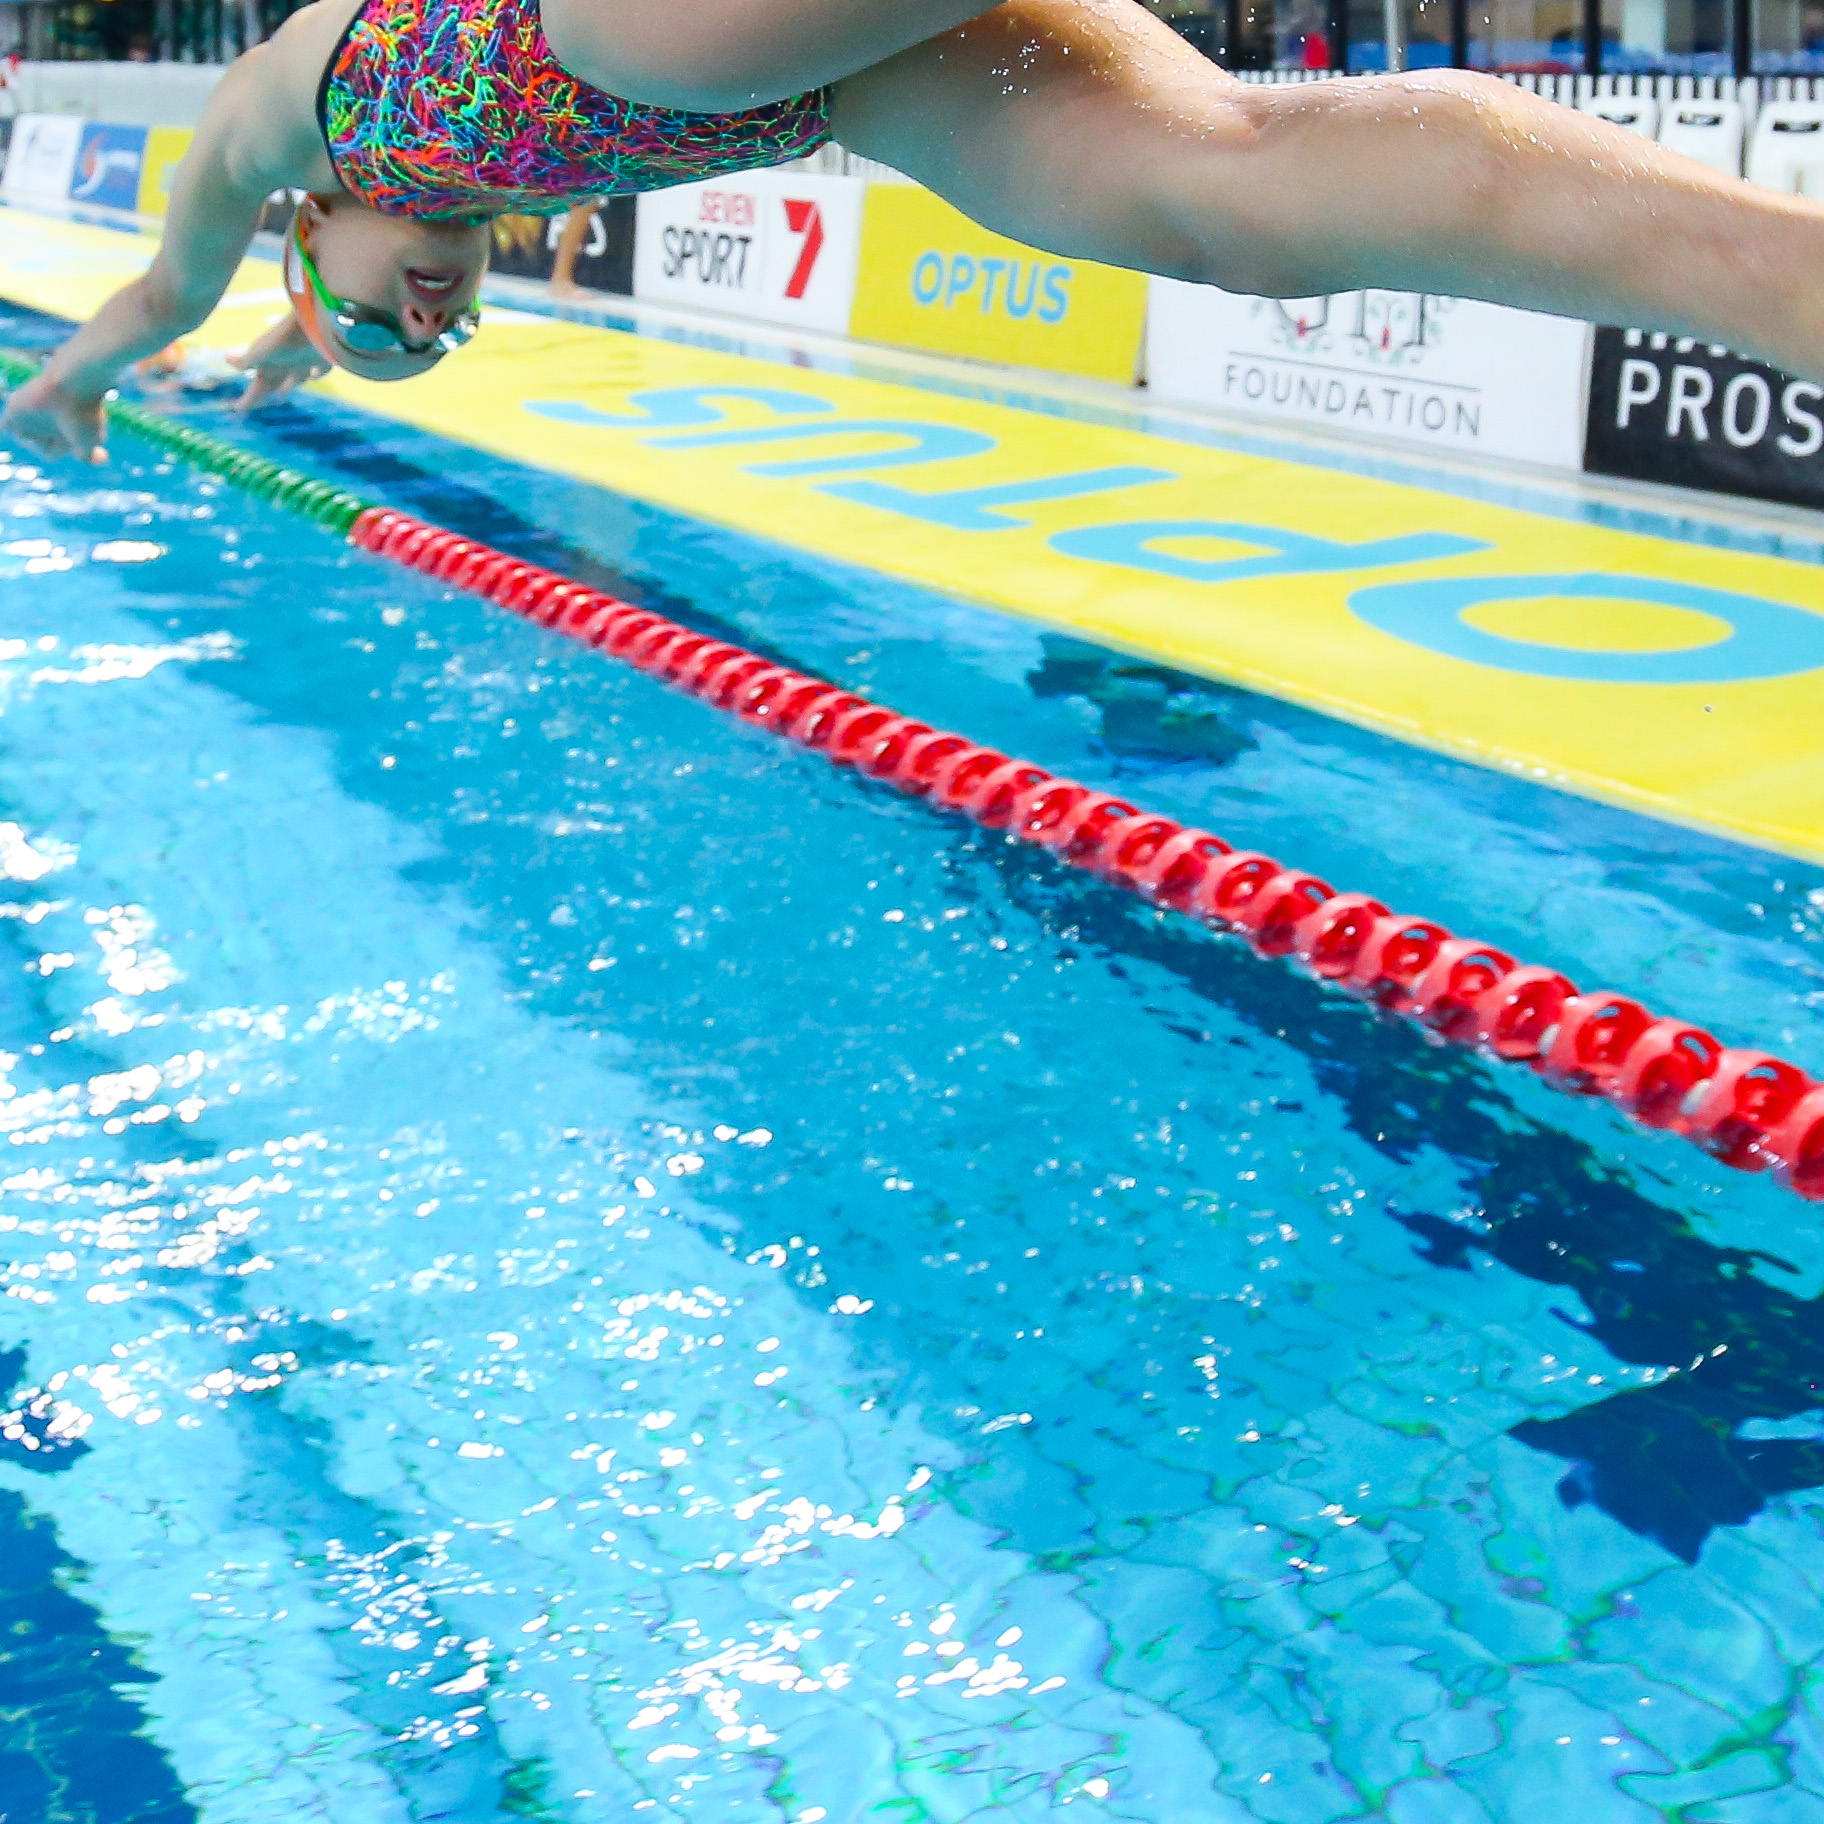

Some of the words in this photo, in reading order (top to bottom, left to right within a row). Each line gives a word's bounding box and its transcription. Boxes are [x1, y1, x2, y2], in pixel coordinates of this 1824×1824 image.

[699, 189, 756, 225] SEVEN
[661, 225, 753, 288] SPORT
[782, 197, 824, 299] 7
[912, 249, 1072, 323] OPTUS
[1223, 363, 1482, 437] FOUNDATION
